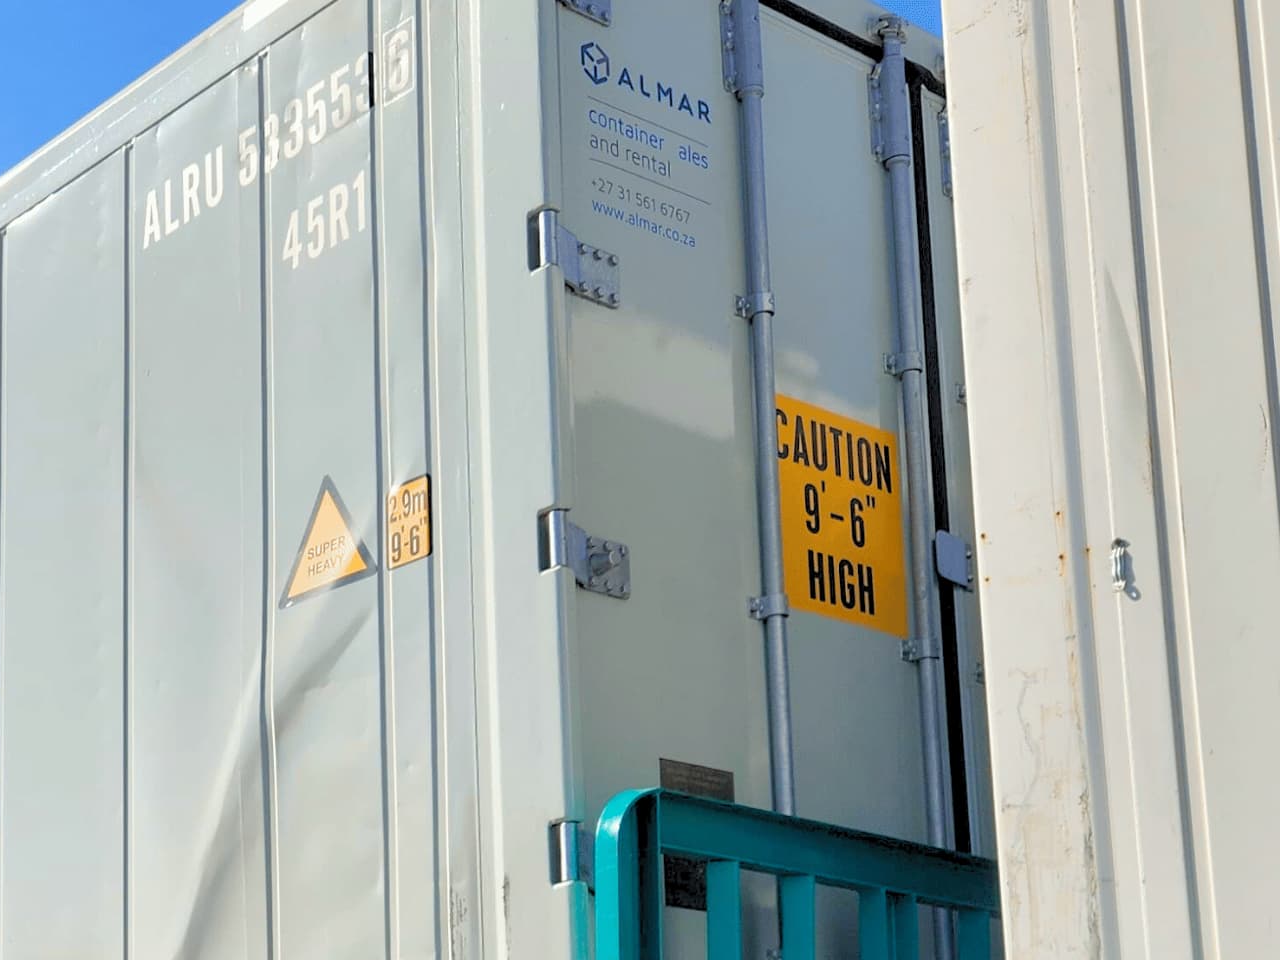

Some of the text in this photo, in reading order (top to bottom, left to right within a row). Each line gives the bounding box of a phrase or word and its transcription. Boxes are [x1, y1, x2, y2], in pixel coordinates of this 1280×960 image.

[618, 67, 712, 124] ALMAR
[143, 145, 223, 249] ALRU
[387, 29, 409, 93] 6
[589, 109, 665, 151] container
[589, 133, 671, 178] and rental
[282, 169, 367, 270] 45R1
[591, 177, 690, 224] +27 31 561 6767
[591, 199, 696, 248] www.almar.co.za
[775, 408, 893, 494] CAUTION
[389, 488, 427, 524] 2.9m
[307, 535, 346, 560] SUPER
[307, 554, 345, 577] HEAVY
[807, 549, 876, 616] HIGH
